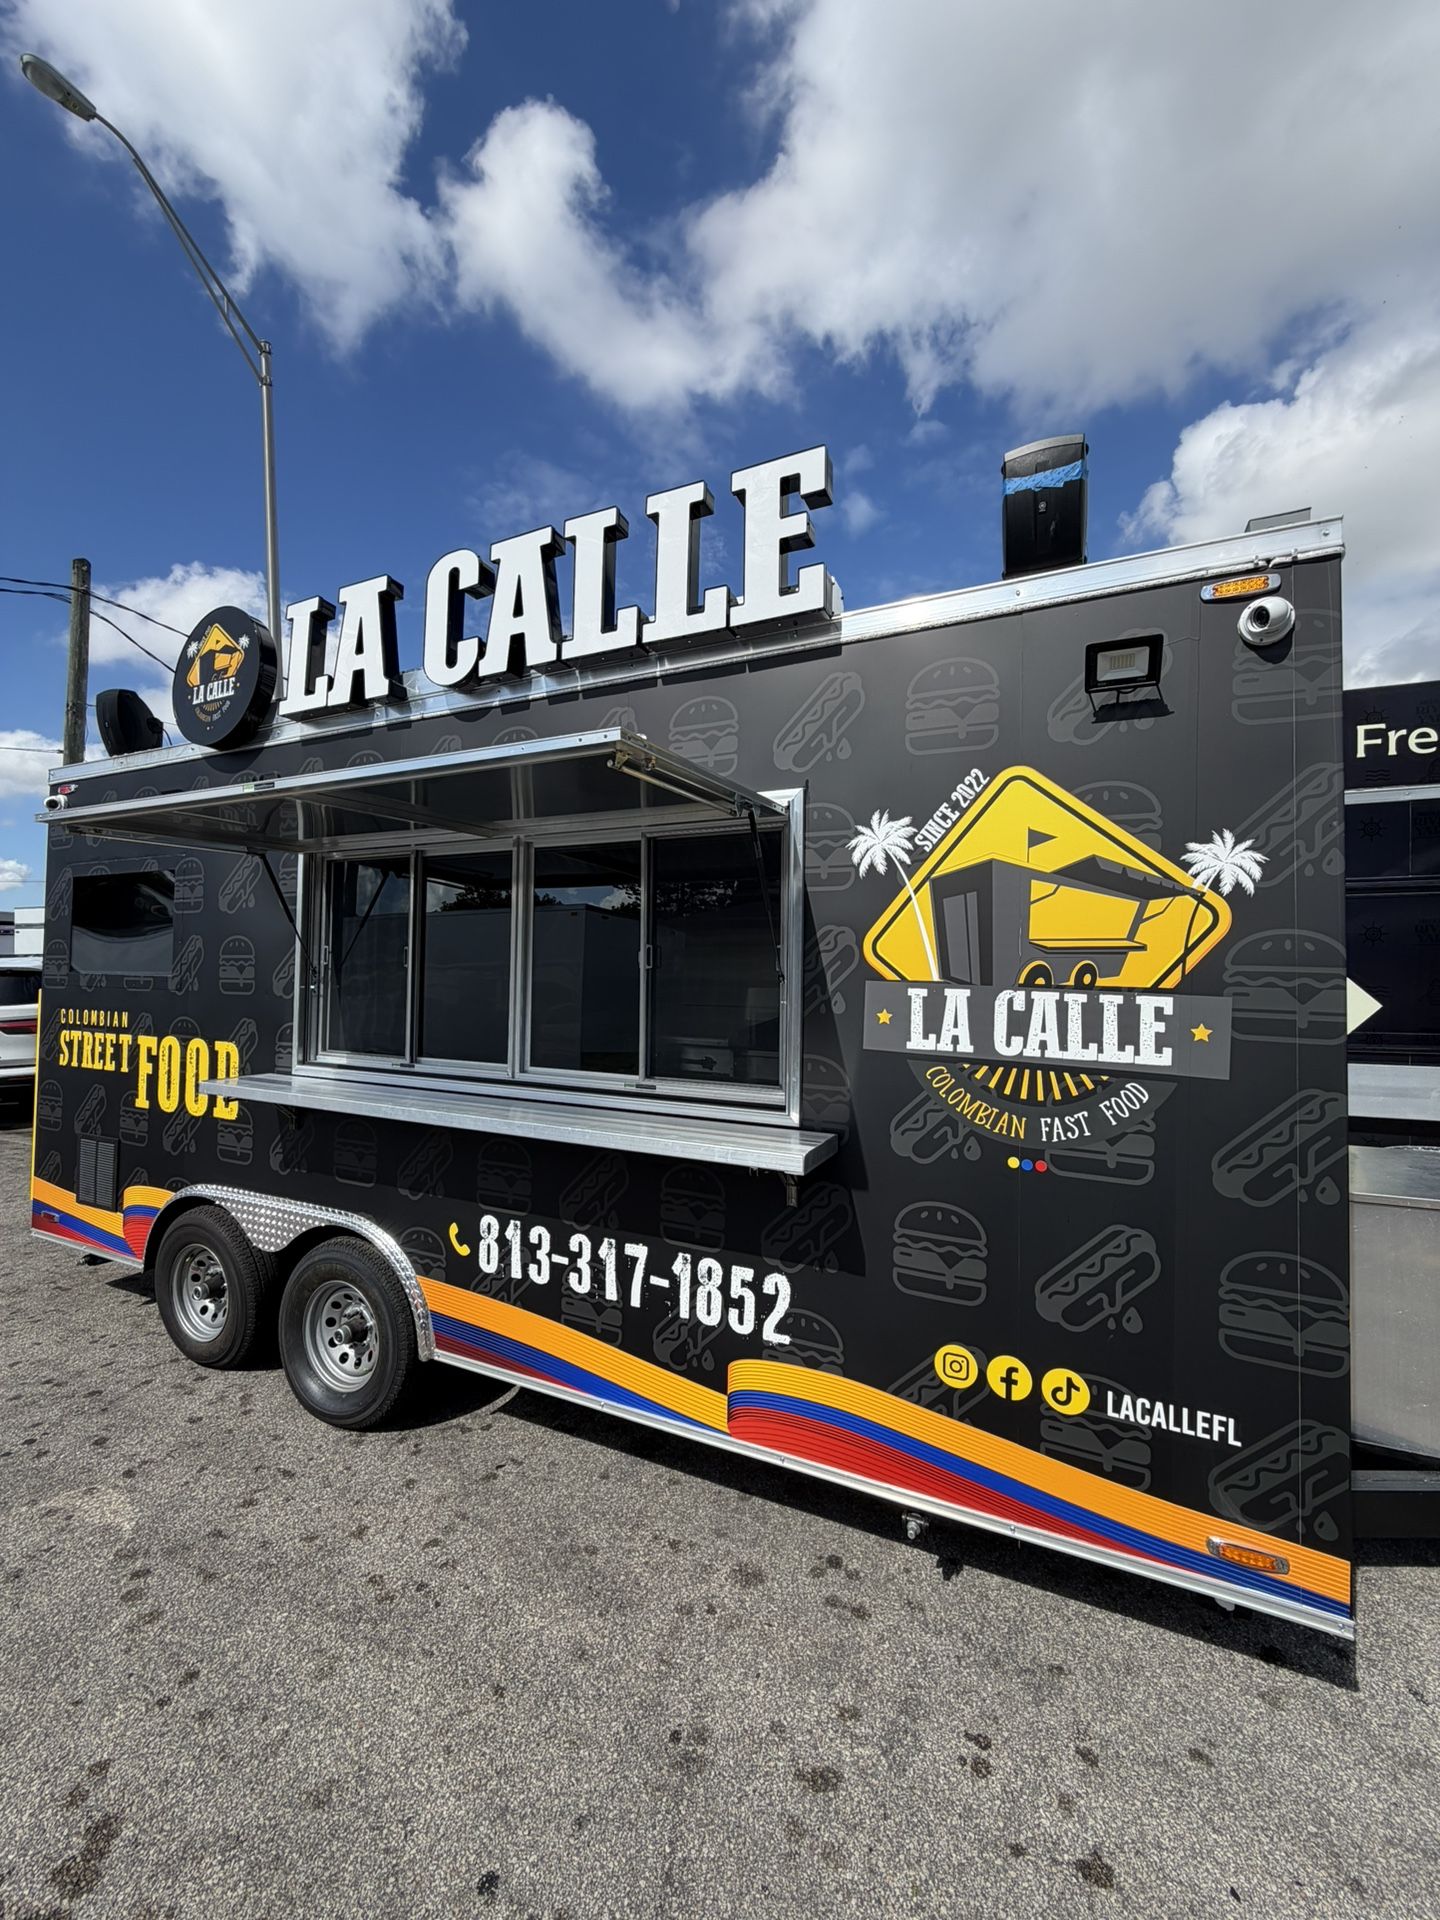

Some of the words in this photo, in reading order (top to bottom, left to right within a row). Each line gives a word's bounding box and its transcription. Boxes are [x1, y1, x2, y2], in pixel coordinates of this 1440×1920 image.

[279, 575, 403, 718] LA
[423, 445, 833, 689] CALLE
[192, 684, 205, 705] LA
[206, 677, 235, 701] CALLE
[914, 802, 961, 852] SINCE
[951, 768, 990, 808] 2022
[60, 1008, 129, 1028] COLOMBIAN
[906, 988, 974, 1053] LA
[993, 990, 1174, 1066] CALLE
[59, 1030, 132, 1073] STREET
[135, 1035, 240, 1120] FOOD
[925, 1065, 1027, 1139] COLOMBIAN
[1040, 1111, 1092, 1142] FAST
[1099, 1082, 1149, 1126] FOOD
[478, 1215, 791, 1345] 813-317-1852
[1107, 1390, 1242, 1447] LACALLEFL
